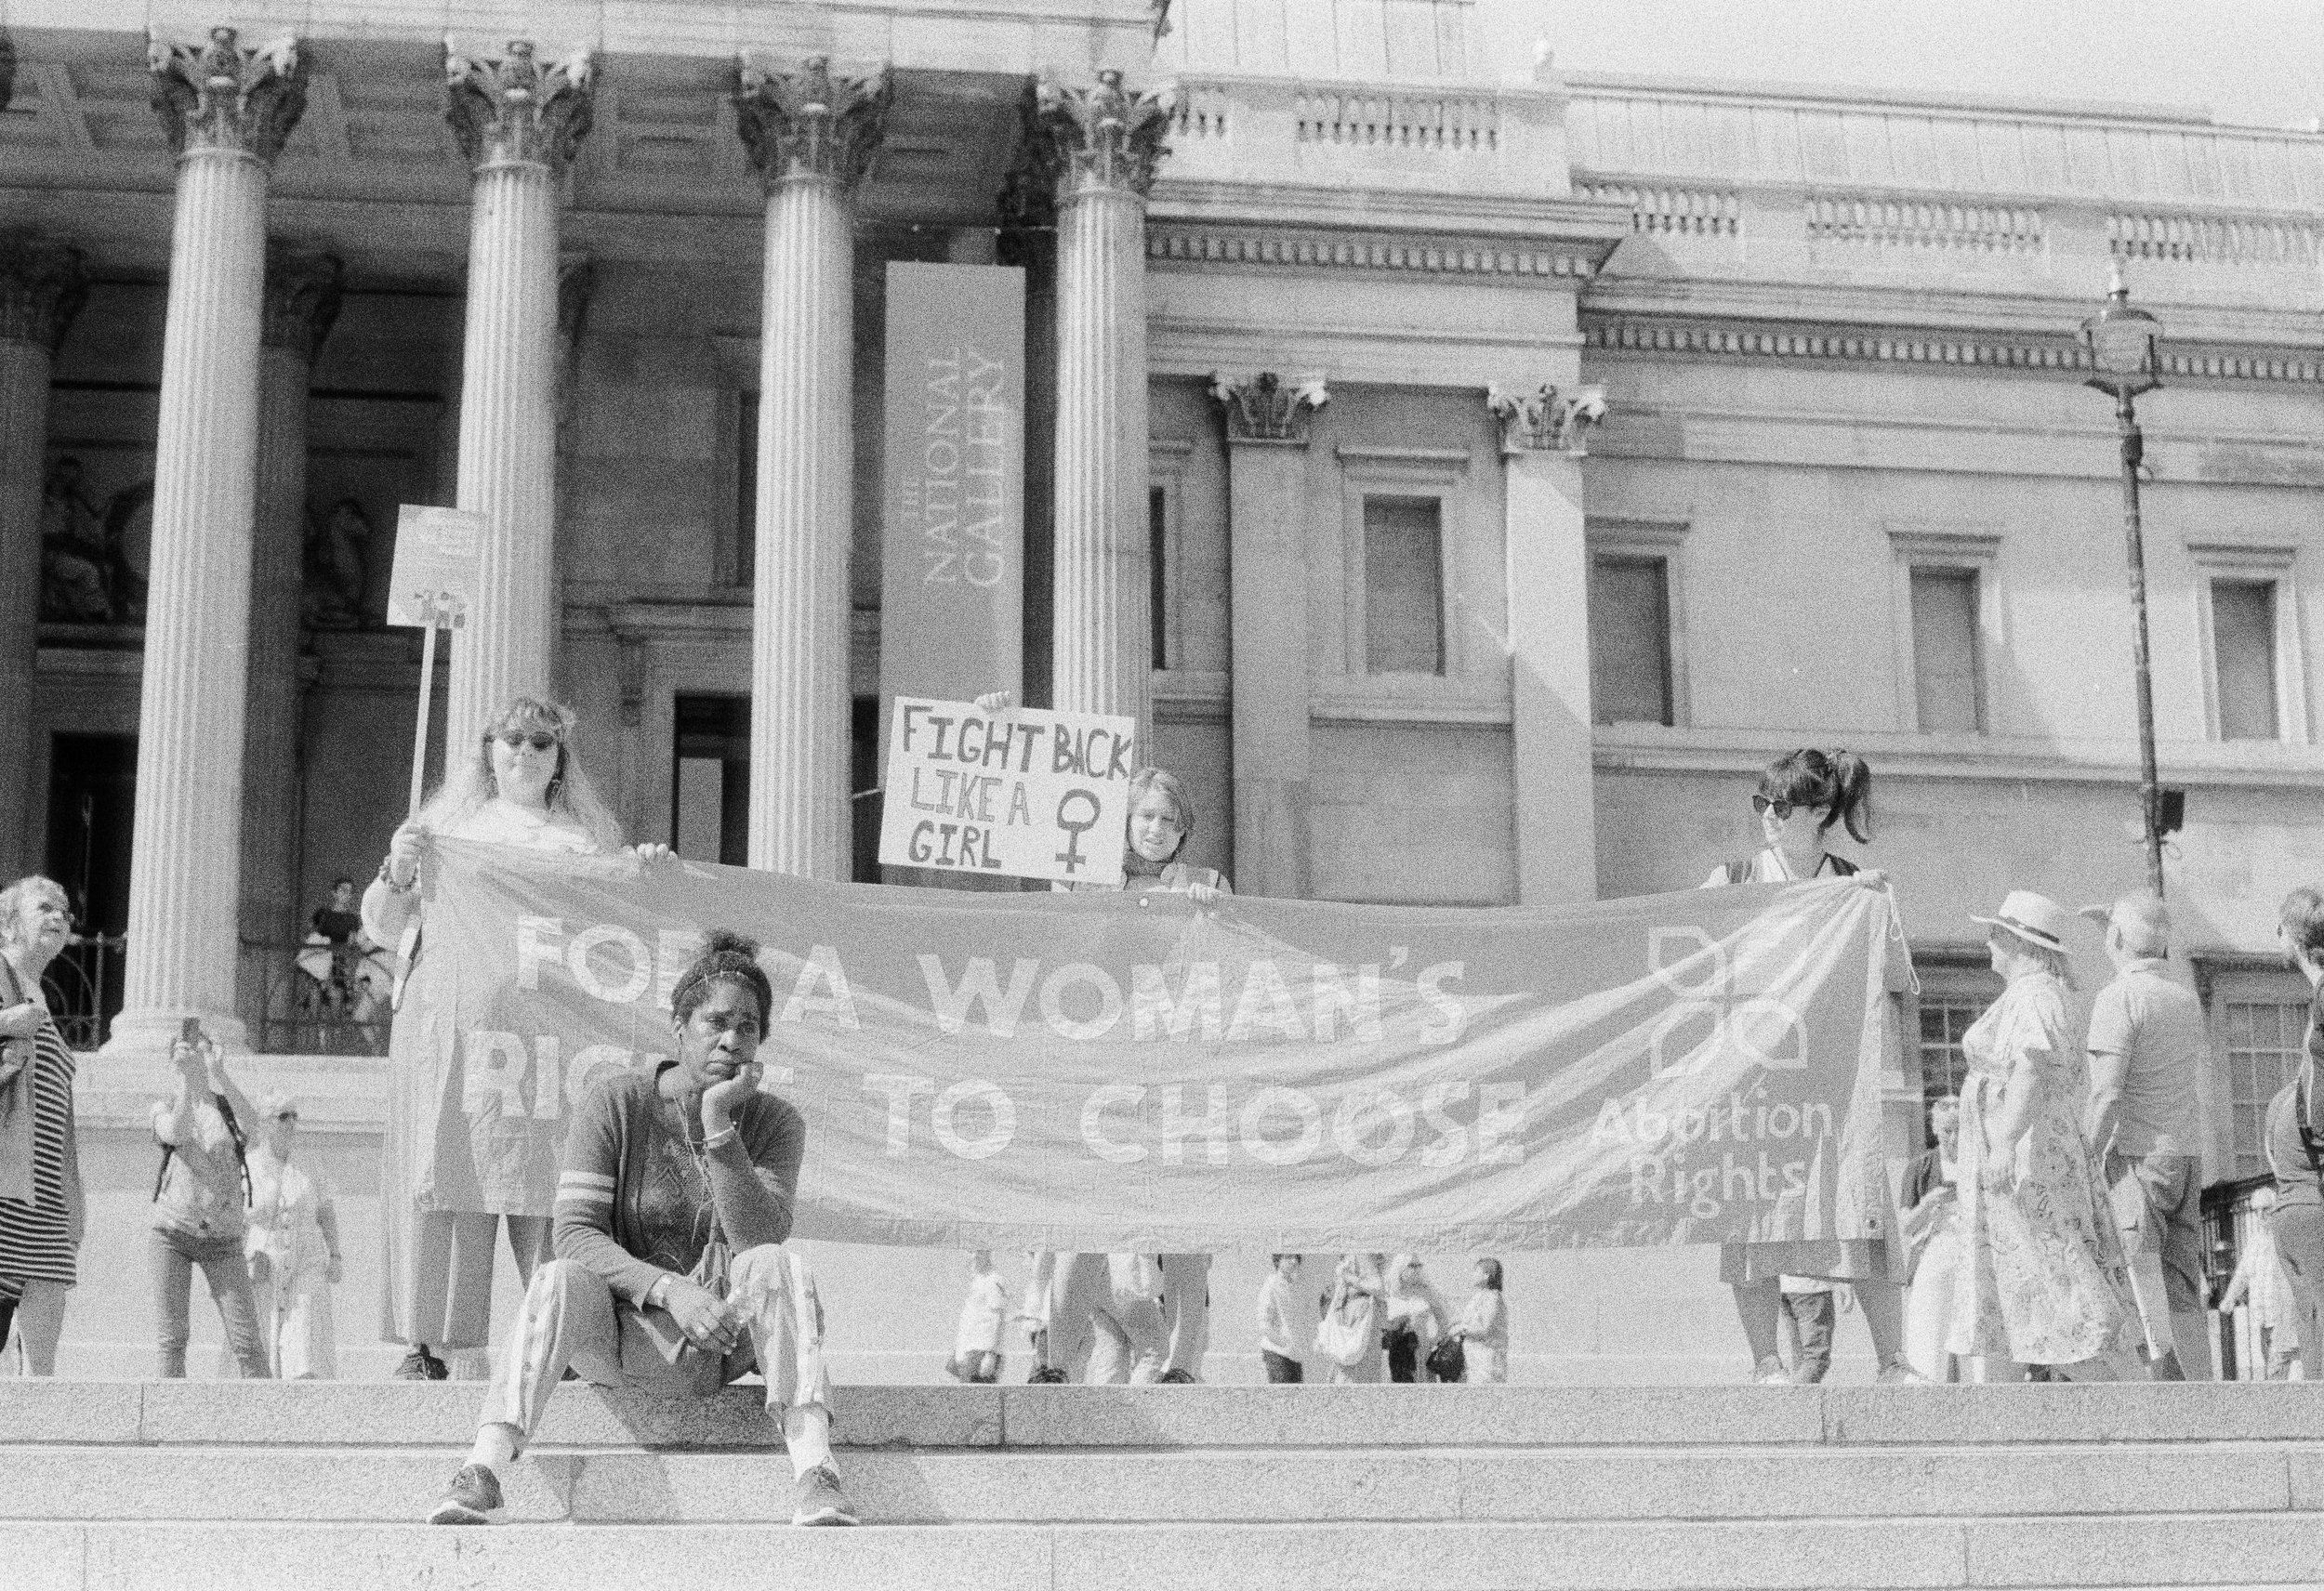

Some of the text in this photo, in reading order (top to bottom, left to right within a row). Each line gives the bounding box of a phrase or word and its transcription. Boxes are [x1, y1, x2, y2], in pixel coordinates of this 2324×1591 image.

[926, 347, 960, 584] NATIONAL
[965, 351, 1004, 587] GALLERY
[904, 704, 1133, 781] FIGHT BACK
[910, 767, 1031, 826] LIKE A
[908, 820, 1002, 869] GIRL
[781, 943, 861, 1030] A
[916, 946, 1466, 1045] WOMAN'S
[864, 1073, 1017, 1160] TO
[1080, 1079, 1526, 1168] CHOOSE
[1591, 1085, 1832, 1147] Abortion
[1631, 1151, 1805, 1218] Rights
